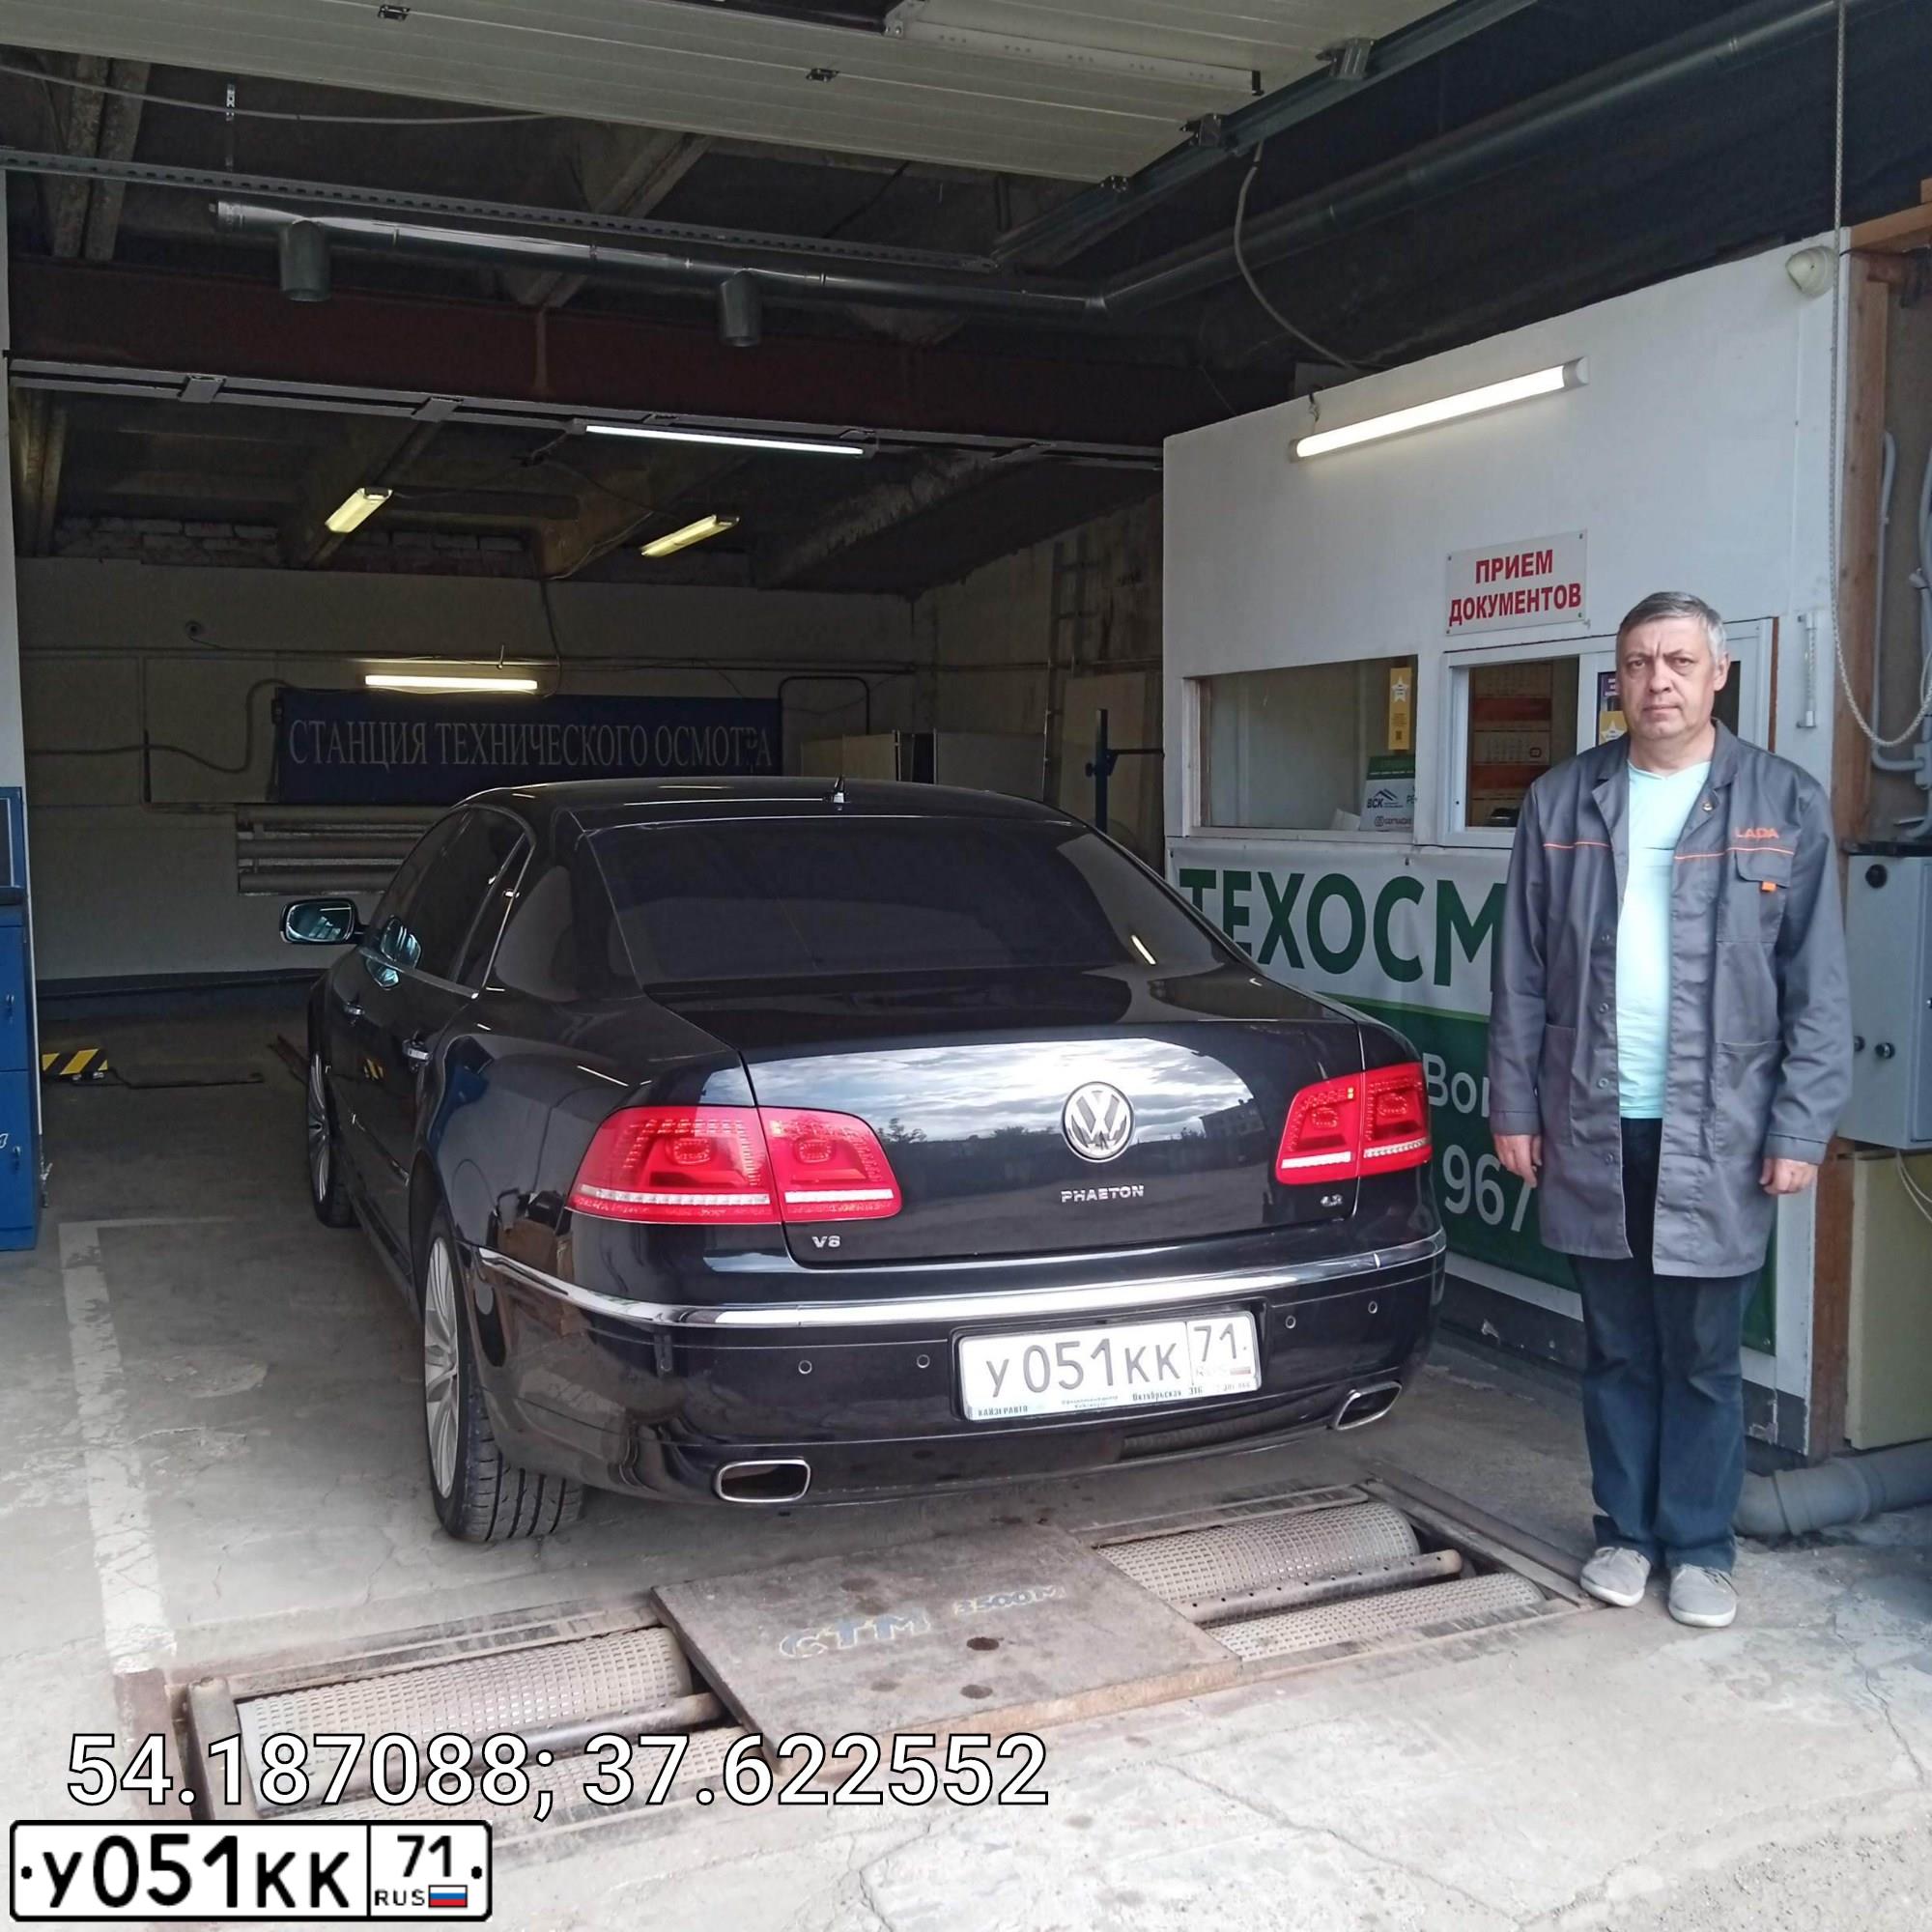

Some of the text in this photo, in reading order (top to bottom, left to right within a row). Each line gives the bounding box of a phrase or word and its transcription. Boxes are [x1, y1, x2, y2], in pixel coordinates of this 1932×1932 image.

[1475, 549, 1553, 584] ПРИЕМ
[1448, 582, 1582, 627] ДОКУМЕНТОВ
[289, 720, 772, 770] СТАНЦИЯ ТЕХНИЧЕСКОГО ОСМОТРА
[1734, 826, 1779, 839] LADA
[1061, 1184, 1145, 1203] PHAETON
[811, 1235, 841, 1248] V8
[1193, 1322, 1237, 1362] 71
